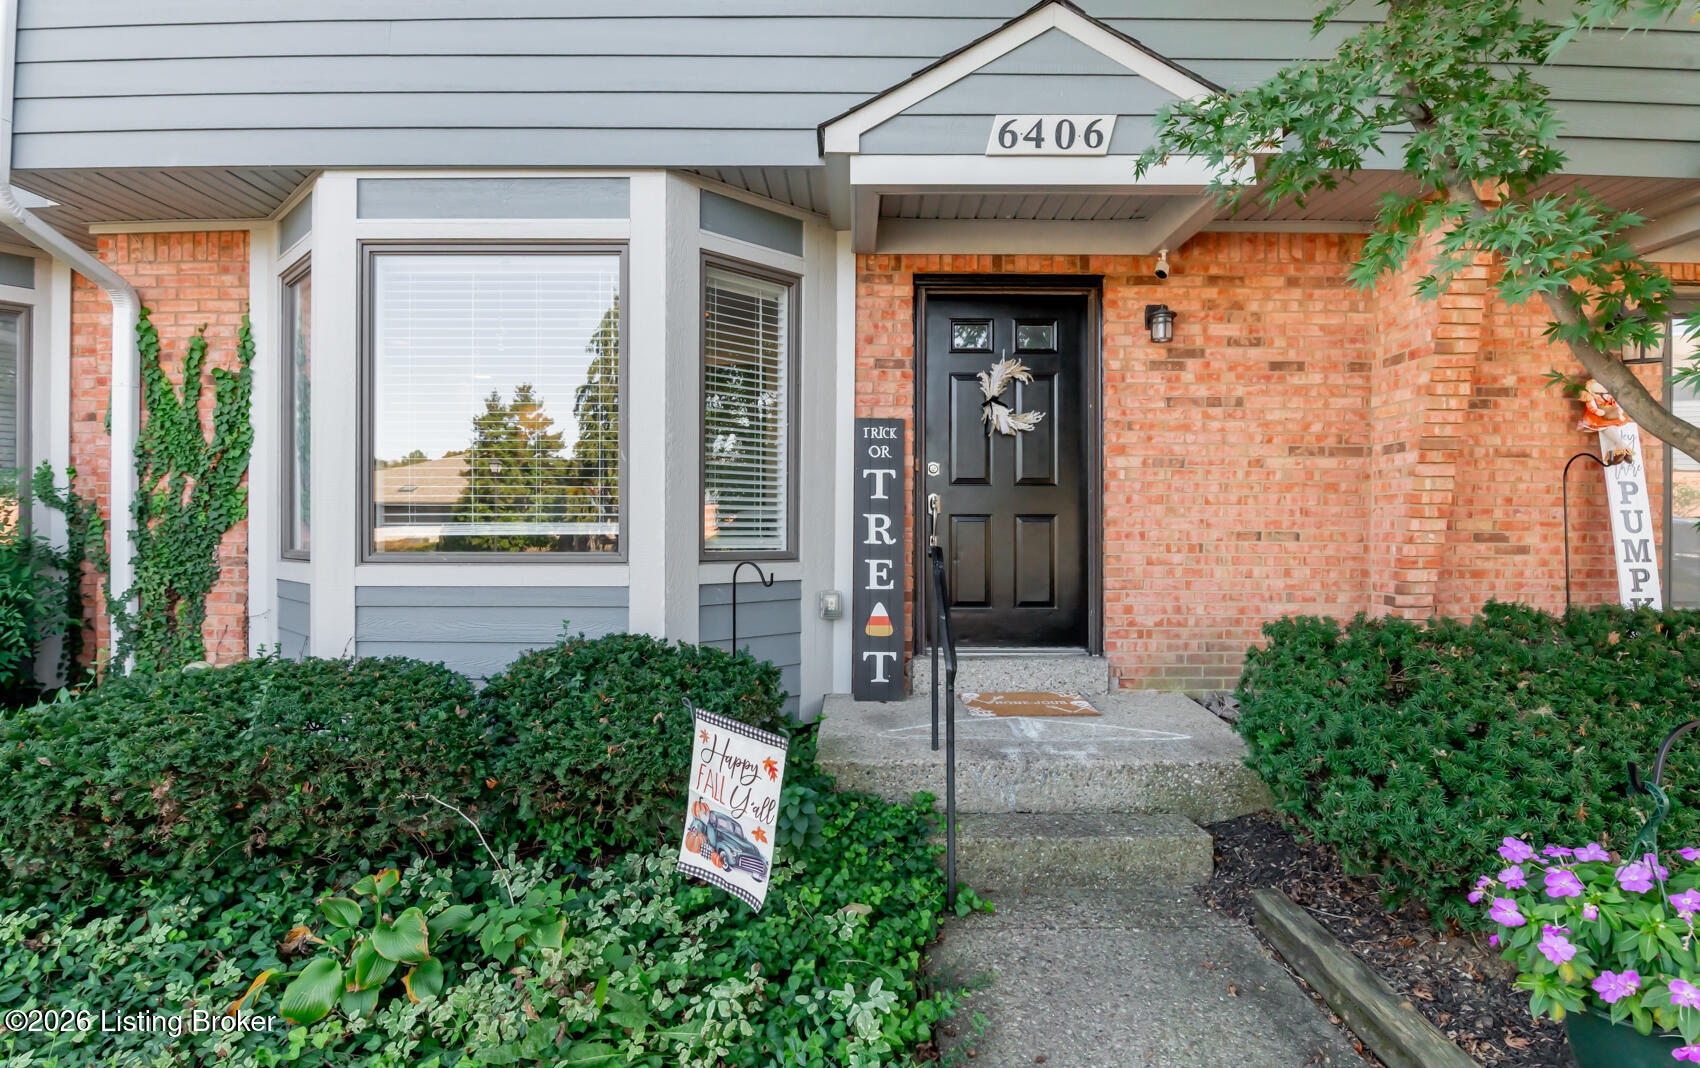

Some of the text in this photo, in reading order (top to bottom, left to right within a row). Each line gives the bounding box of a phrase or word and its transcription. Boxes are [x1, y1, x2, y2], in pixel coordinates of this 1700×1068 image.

[998, 118, 1104, 150] 6406
[863, 426, 898, 439] TRICK
[868, 445, 892, 458] OR
[862, 469, 897, 683] TRET
[701, 734, 762, 786] Happy
[696, 763, 776, 824] FALL Y'all
